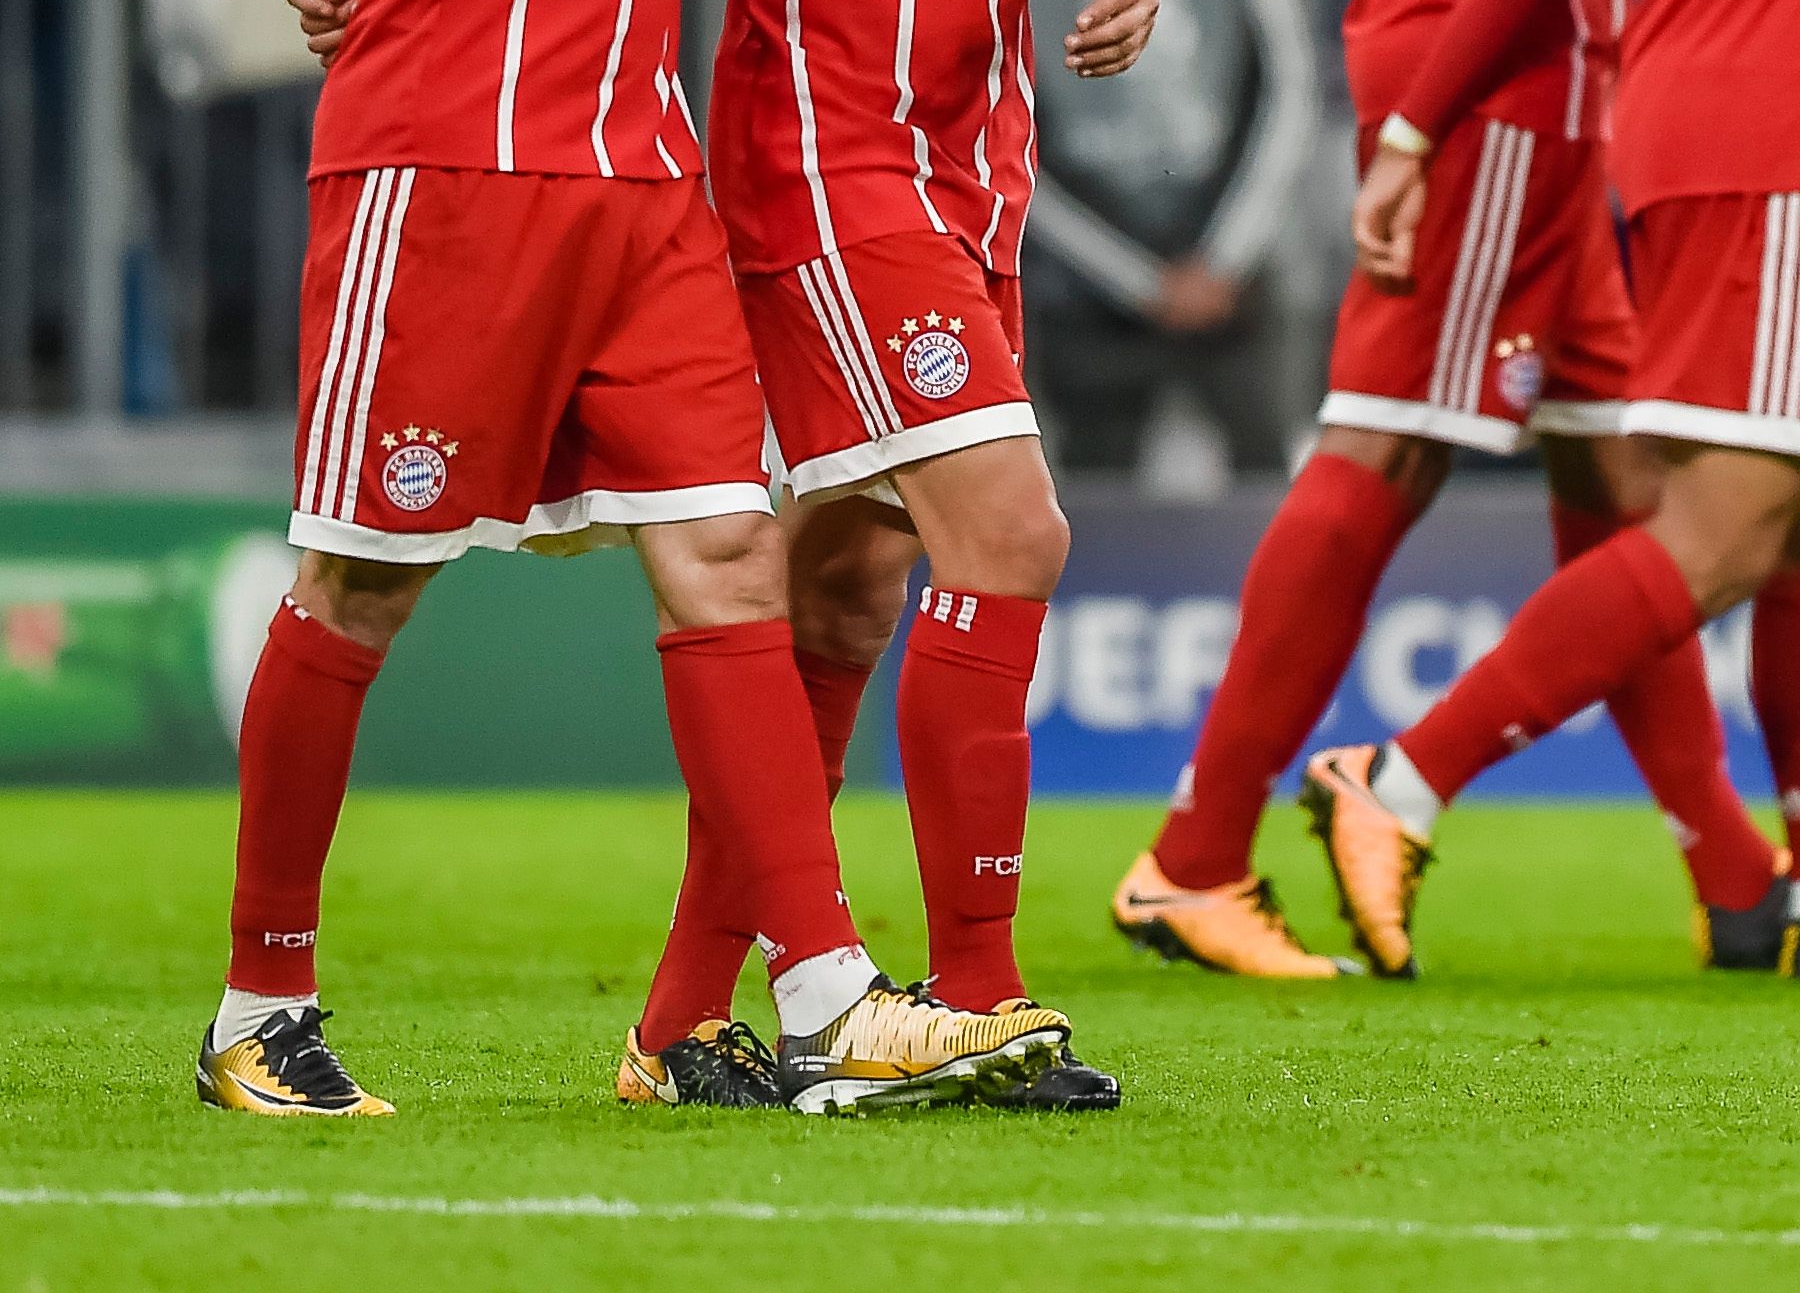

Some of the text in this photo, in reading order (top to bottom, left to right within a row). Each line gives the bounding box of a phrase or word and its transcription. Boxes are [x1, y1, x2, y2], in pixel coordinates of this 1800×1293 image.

[913, 335, 961, 357] BAYERN
[974, 854, 1023, 876] FCB
[264, 930, 316, 948] FCB
